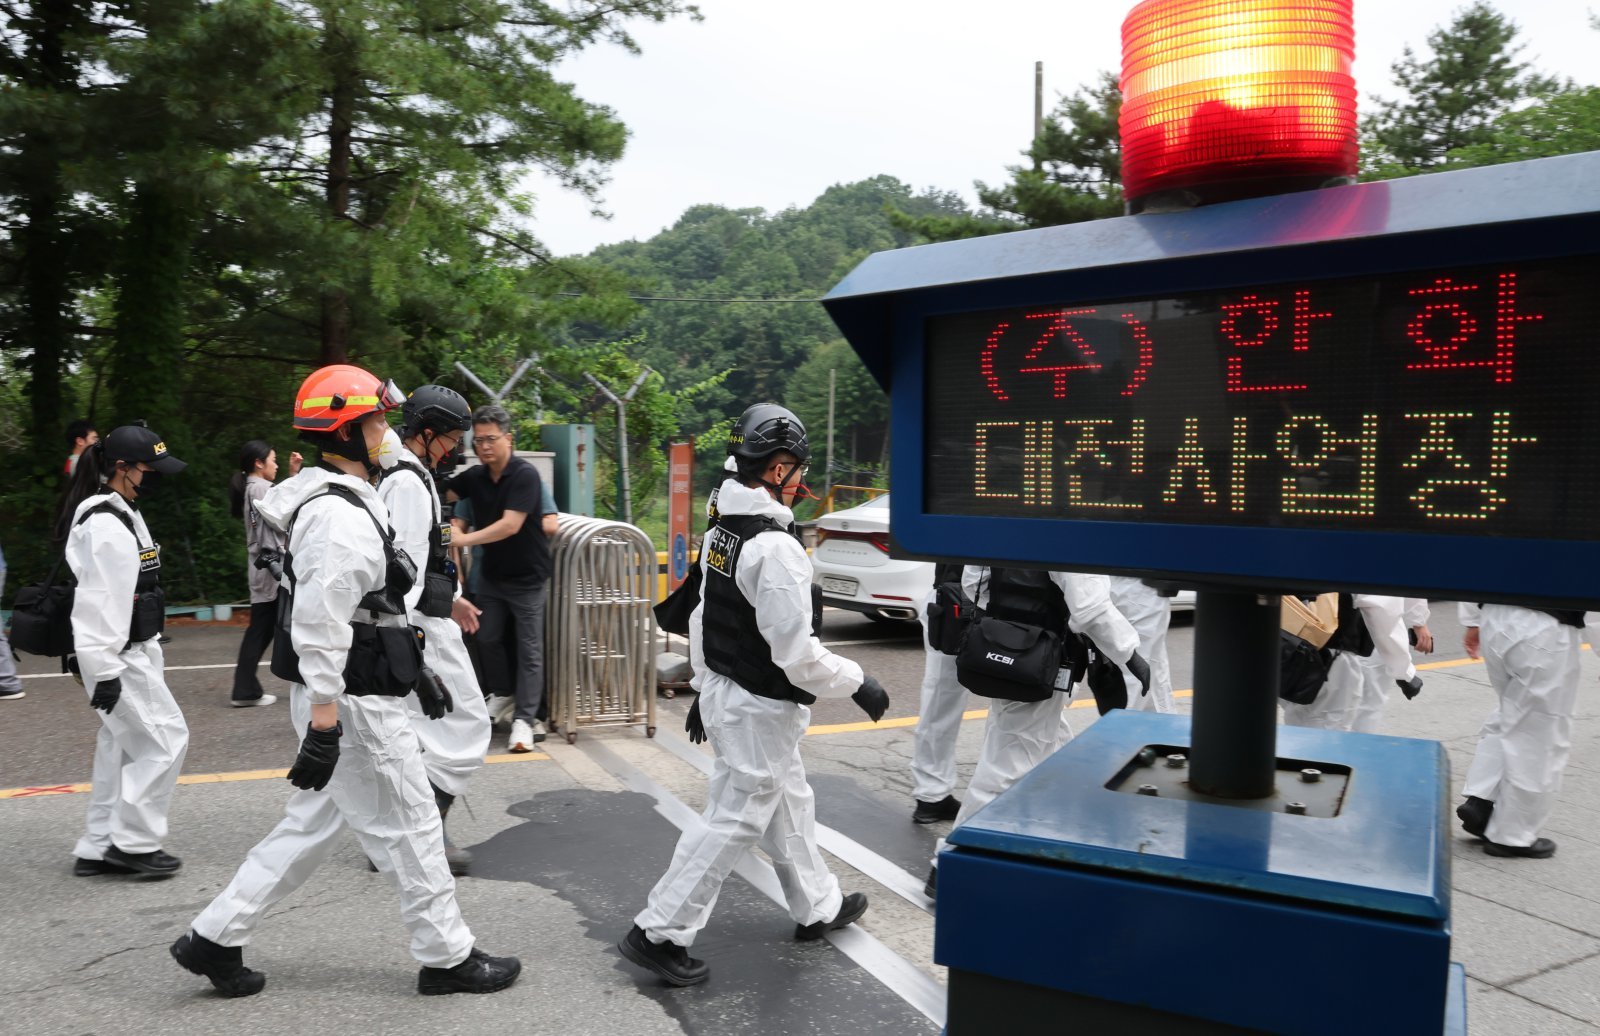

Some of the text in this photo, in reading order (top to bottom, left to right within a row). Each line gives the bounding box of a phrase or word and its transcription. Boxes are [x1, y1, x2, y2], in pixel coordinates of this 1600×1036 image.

[982, 310, 1152, 399] (주)
[975, 413, 1536, 518] 대전사업장
[986, 651, 1015, 665] KCSI
